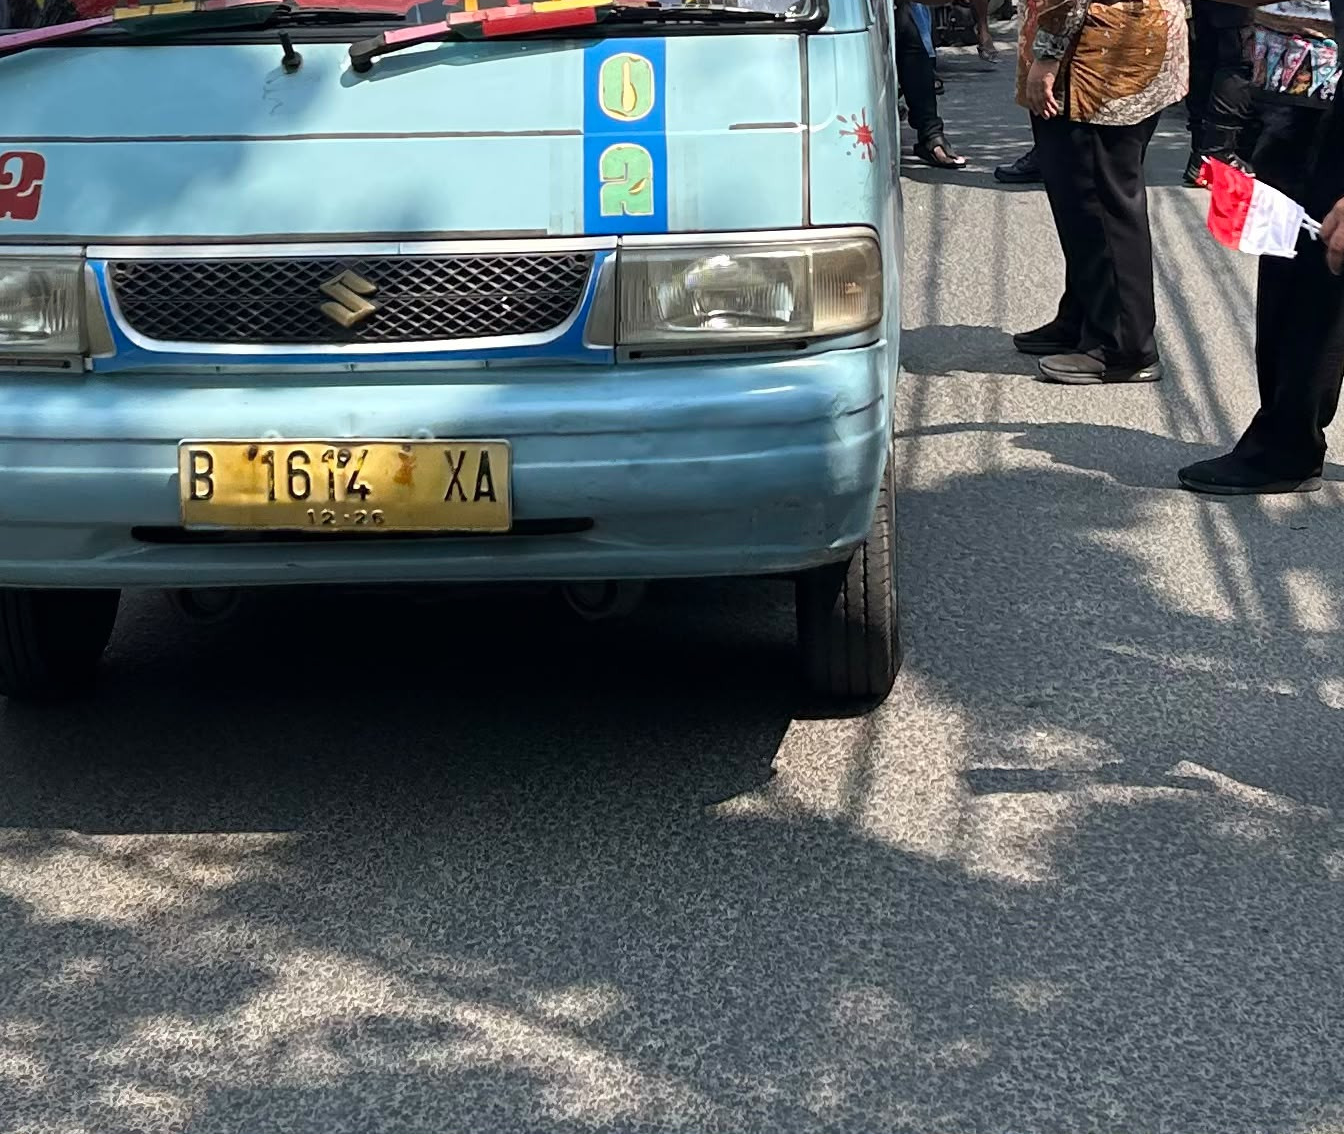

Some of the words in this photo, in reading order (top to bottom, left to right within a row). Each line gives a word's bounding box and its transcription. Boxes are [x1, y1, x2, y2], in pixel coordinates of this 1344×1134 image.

[188, 449, 214, 501] B
[261, 448, 372, 502] 1614
[443, 449, 497, 503] XA
